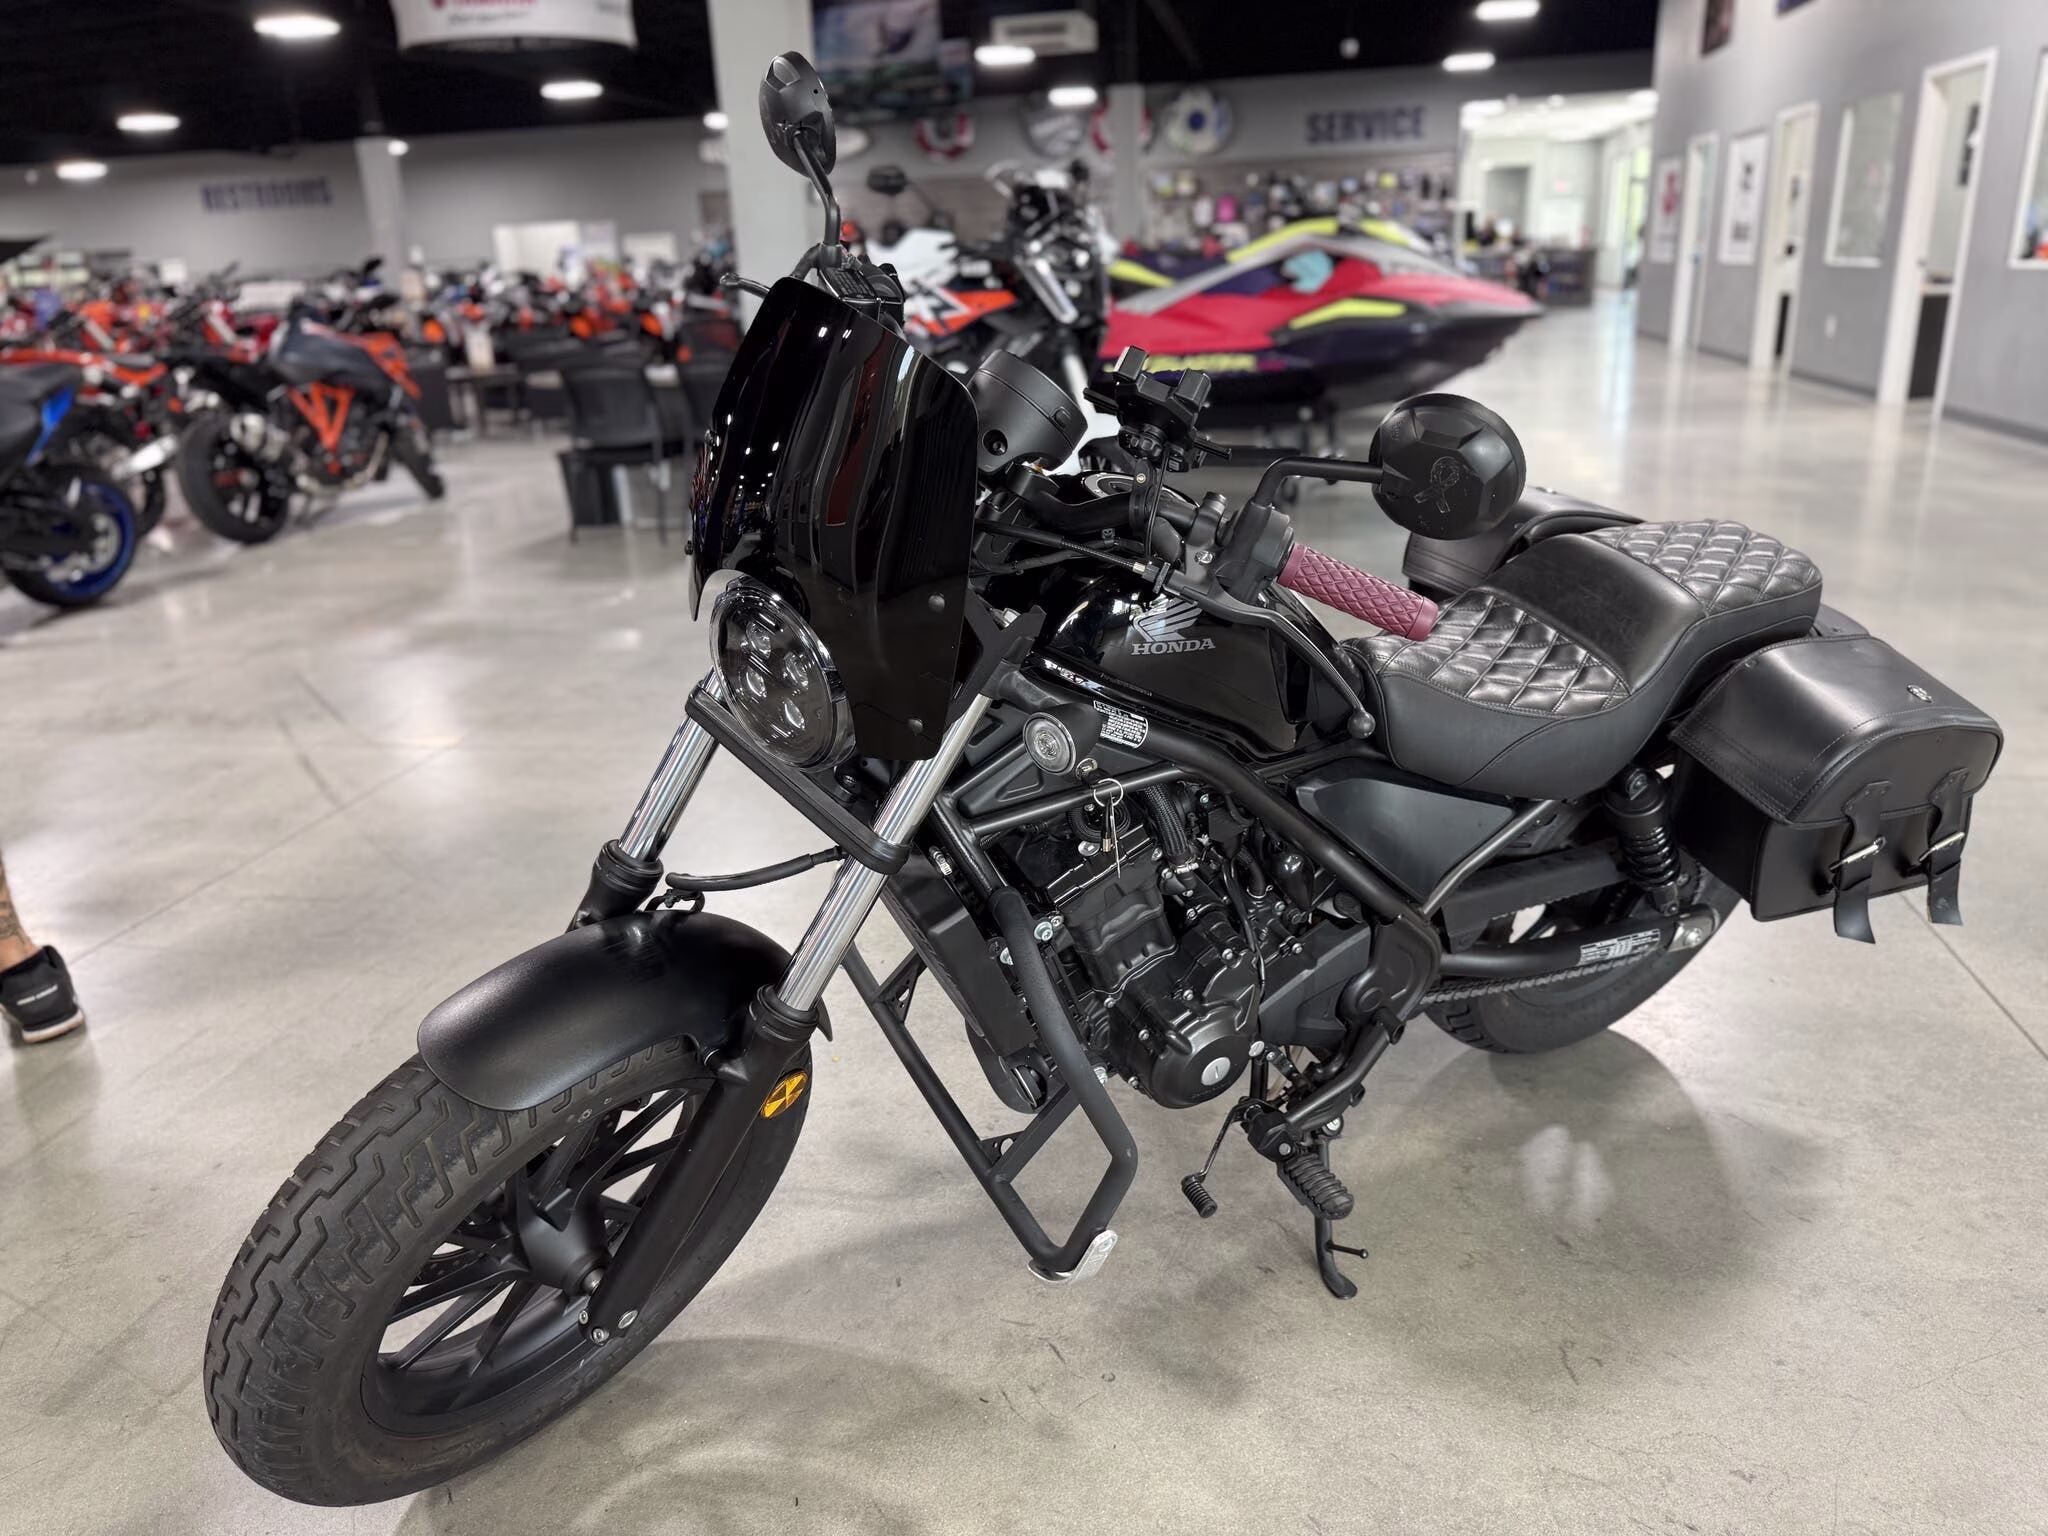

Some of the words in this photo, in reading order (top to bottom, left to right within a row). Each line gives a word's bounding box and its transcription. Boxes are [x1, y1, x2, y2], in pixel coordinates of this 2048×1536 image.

[1305, 106, 1425, 145] SERVICE
[201, 177, 332, 213] RESTROOMS
[1131, 638, 1216, 656] HONDA
